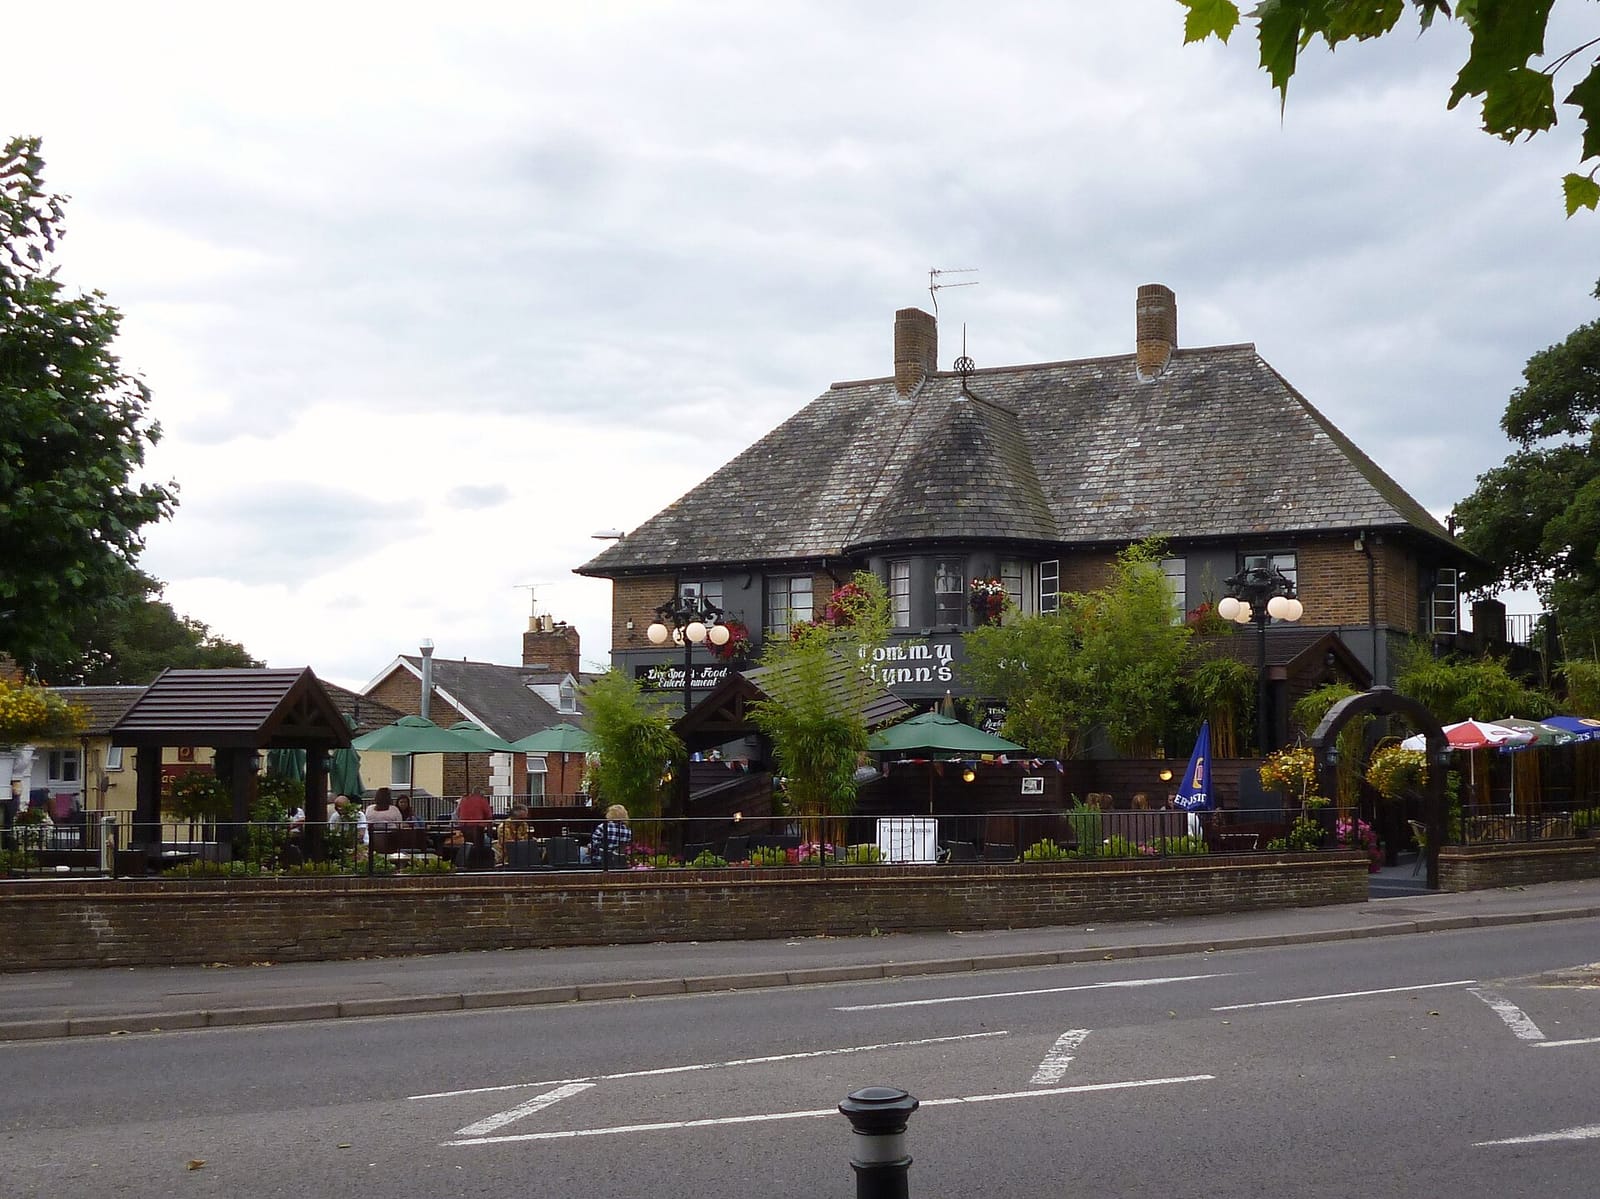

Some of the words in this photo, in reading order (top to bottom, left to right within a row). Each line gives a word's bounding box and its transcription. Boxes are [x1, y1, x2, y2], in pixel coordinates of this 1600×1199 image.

[701, 667, 728, 678] Food
[861, 664, 953, 687] lynn's
[659, 678, 717, 687] Entertnment
